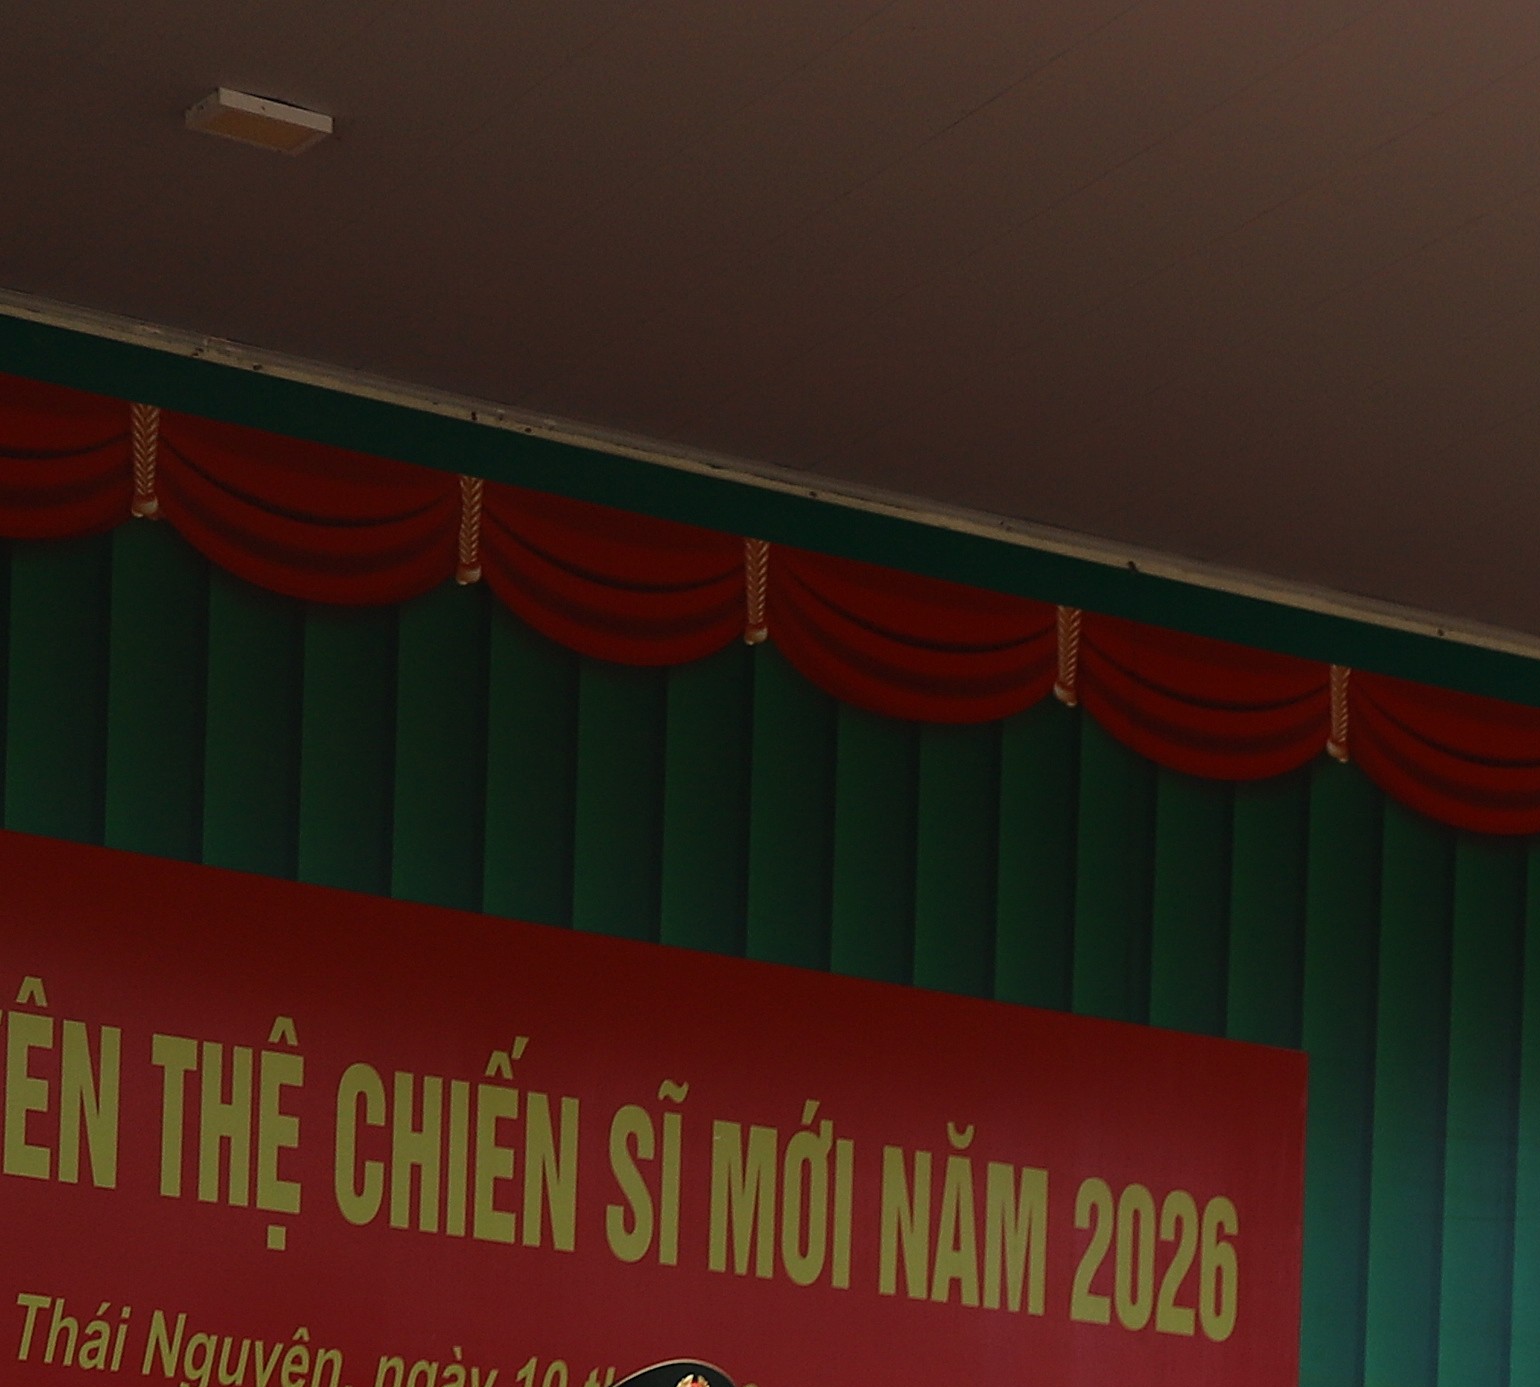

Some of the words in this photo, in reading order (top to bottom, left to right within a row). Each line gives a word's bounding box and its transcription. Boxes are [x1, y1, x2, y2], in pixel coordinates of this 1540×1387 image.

[0, 976, 121, 1189] ÊN
[151, 1016, 304, 1250] THỆ
[334, 1036, 580, 1252] CHIẾN
[605, 1080, 689, 1265] SĨ
[708, 1100, 854, 1289] MỚI
[879, 1122, 1048, 1315] NĂM
[1070, 1177, 1239, 1342] 2026
[17, 1293, 131, 1372] Thái
